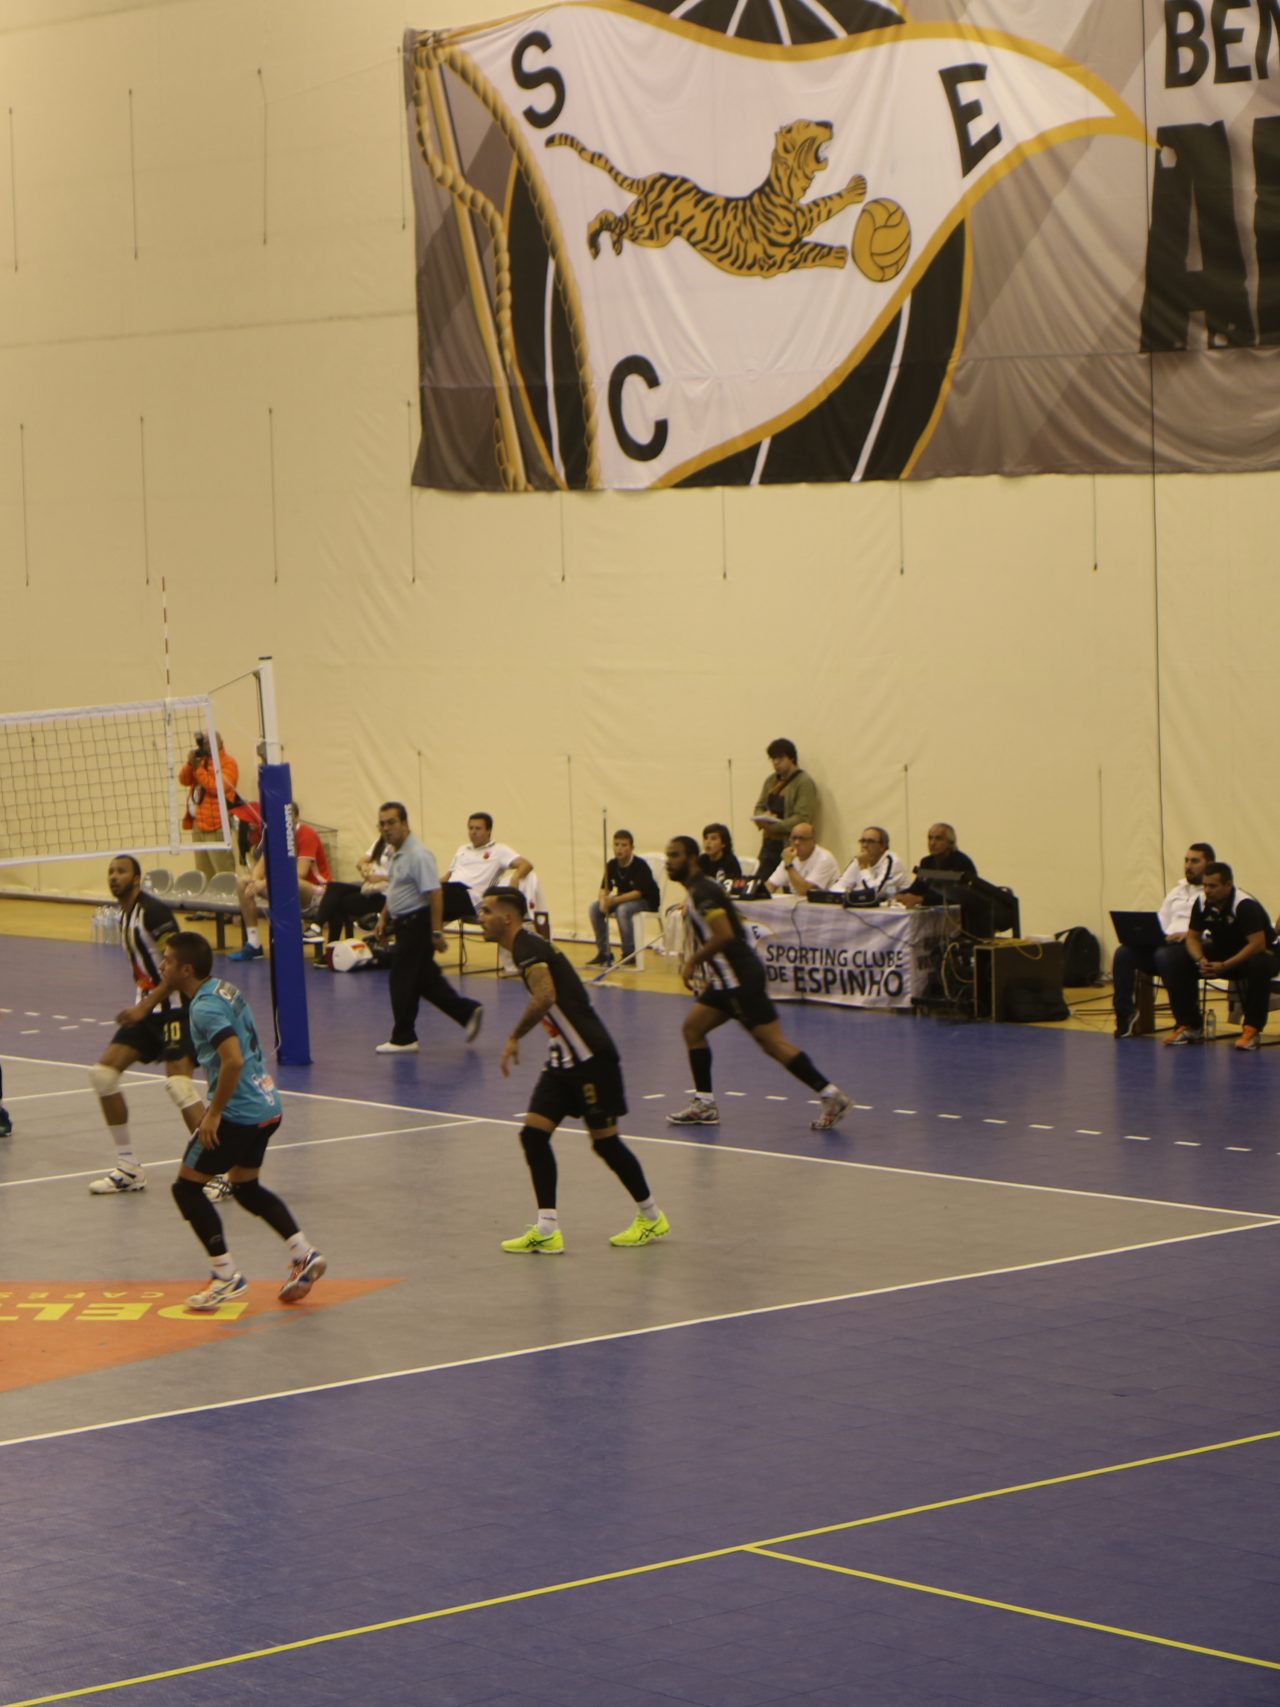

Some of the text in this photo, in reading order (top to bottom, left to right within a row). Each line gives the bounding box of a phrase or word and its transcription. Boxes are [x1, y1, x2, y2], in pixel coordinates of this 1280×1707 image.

[511, 30, 567, 129] S
[939, 63, 1003, 178] E
[1140, 115, 1280, 353] A
[607, 355, 669, 462] C
[766, 944, 903, 969] SPORTING CLUBE
[766, 964, 903, 998] DE ESPINHO
[163, 1021, 181, 1042] 10
